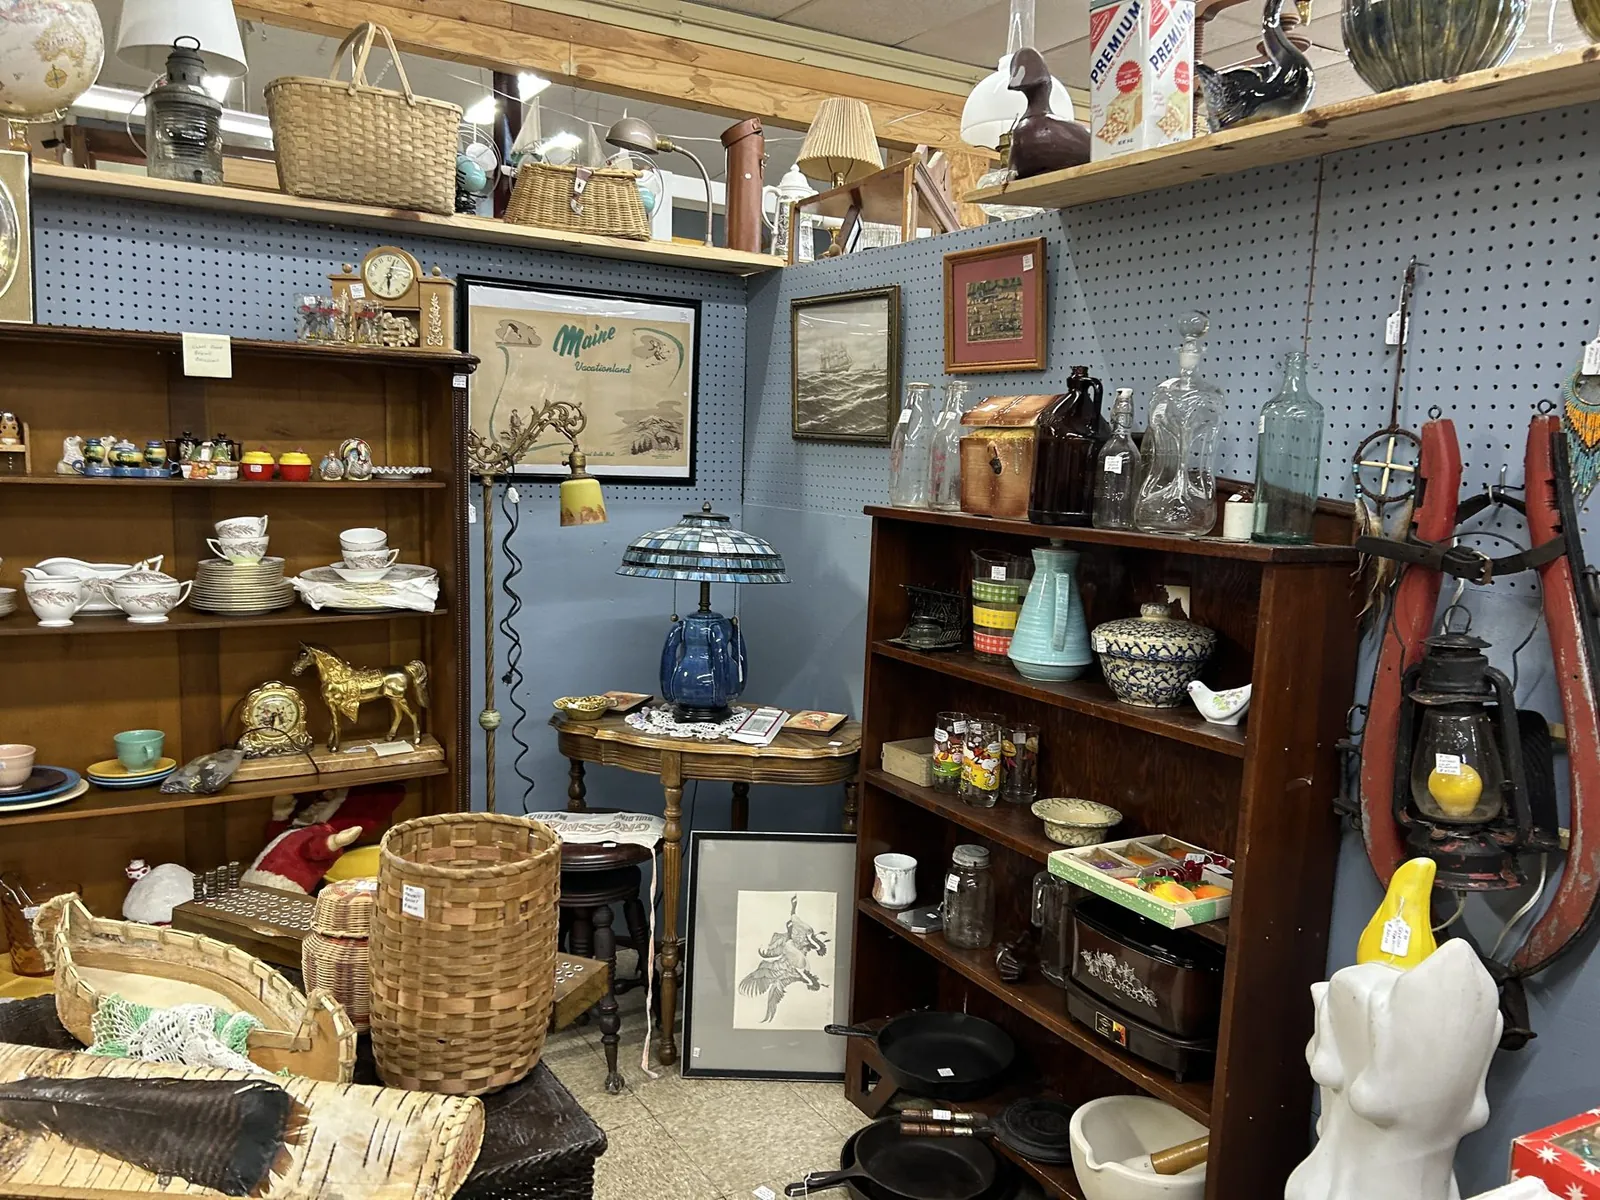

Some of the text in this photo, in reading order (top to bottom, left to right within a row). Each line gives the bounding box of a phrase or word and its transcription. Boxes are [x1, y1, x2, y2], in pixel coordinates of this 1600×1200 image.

[1090, 1, 1141, 84] PREMIUM
[1149, 4, 1193, 71] PREMIUM
[552, 323, 616, 359] Maine
[574, 361, 632, 374] Vacationland
[545, 820, 650, 832] GROSSMA
